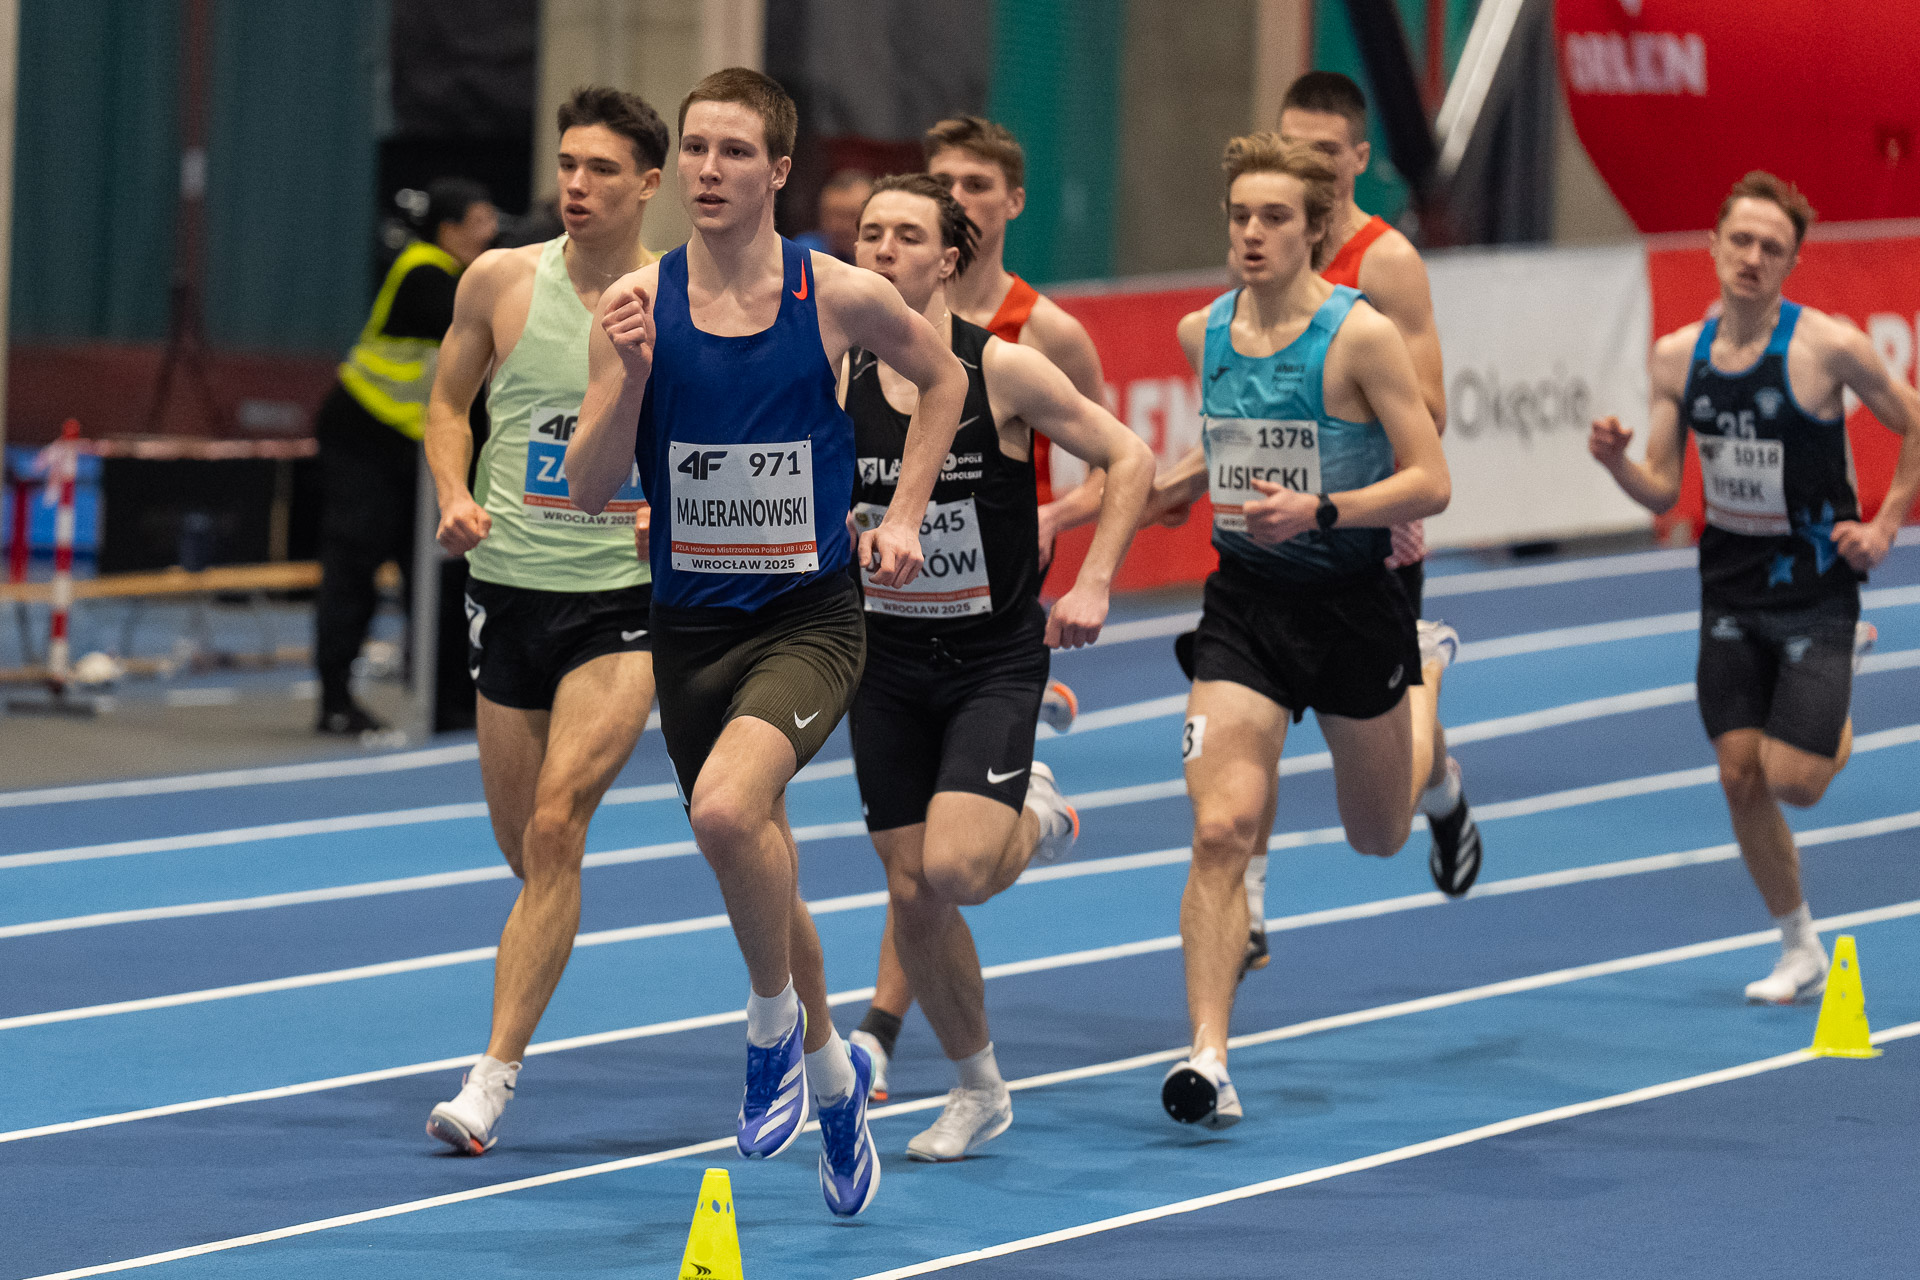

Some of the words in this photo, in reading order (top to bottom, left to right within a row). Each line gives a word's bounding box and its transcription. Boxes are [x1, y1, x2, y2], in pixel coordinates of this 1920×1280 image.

[1258, 427, 1315, 450] 1378
[677, 450, 728, 481] 4F
[748, 450, 801, 477] 971
[677, 497, 807, 527] MAJERANOWSKI
[716, 546, 760, 554] Mistrzostwa
[761, 545, 782, 554] Polski
[691, 558, 762, 571] WROCŁAW
[764, 558, 796, 571] 2025
